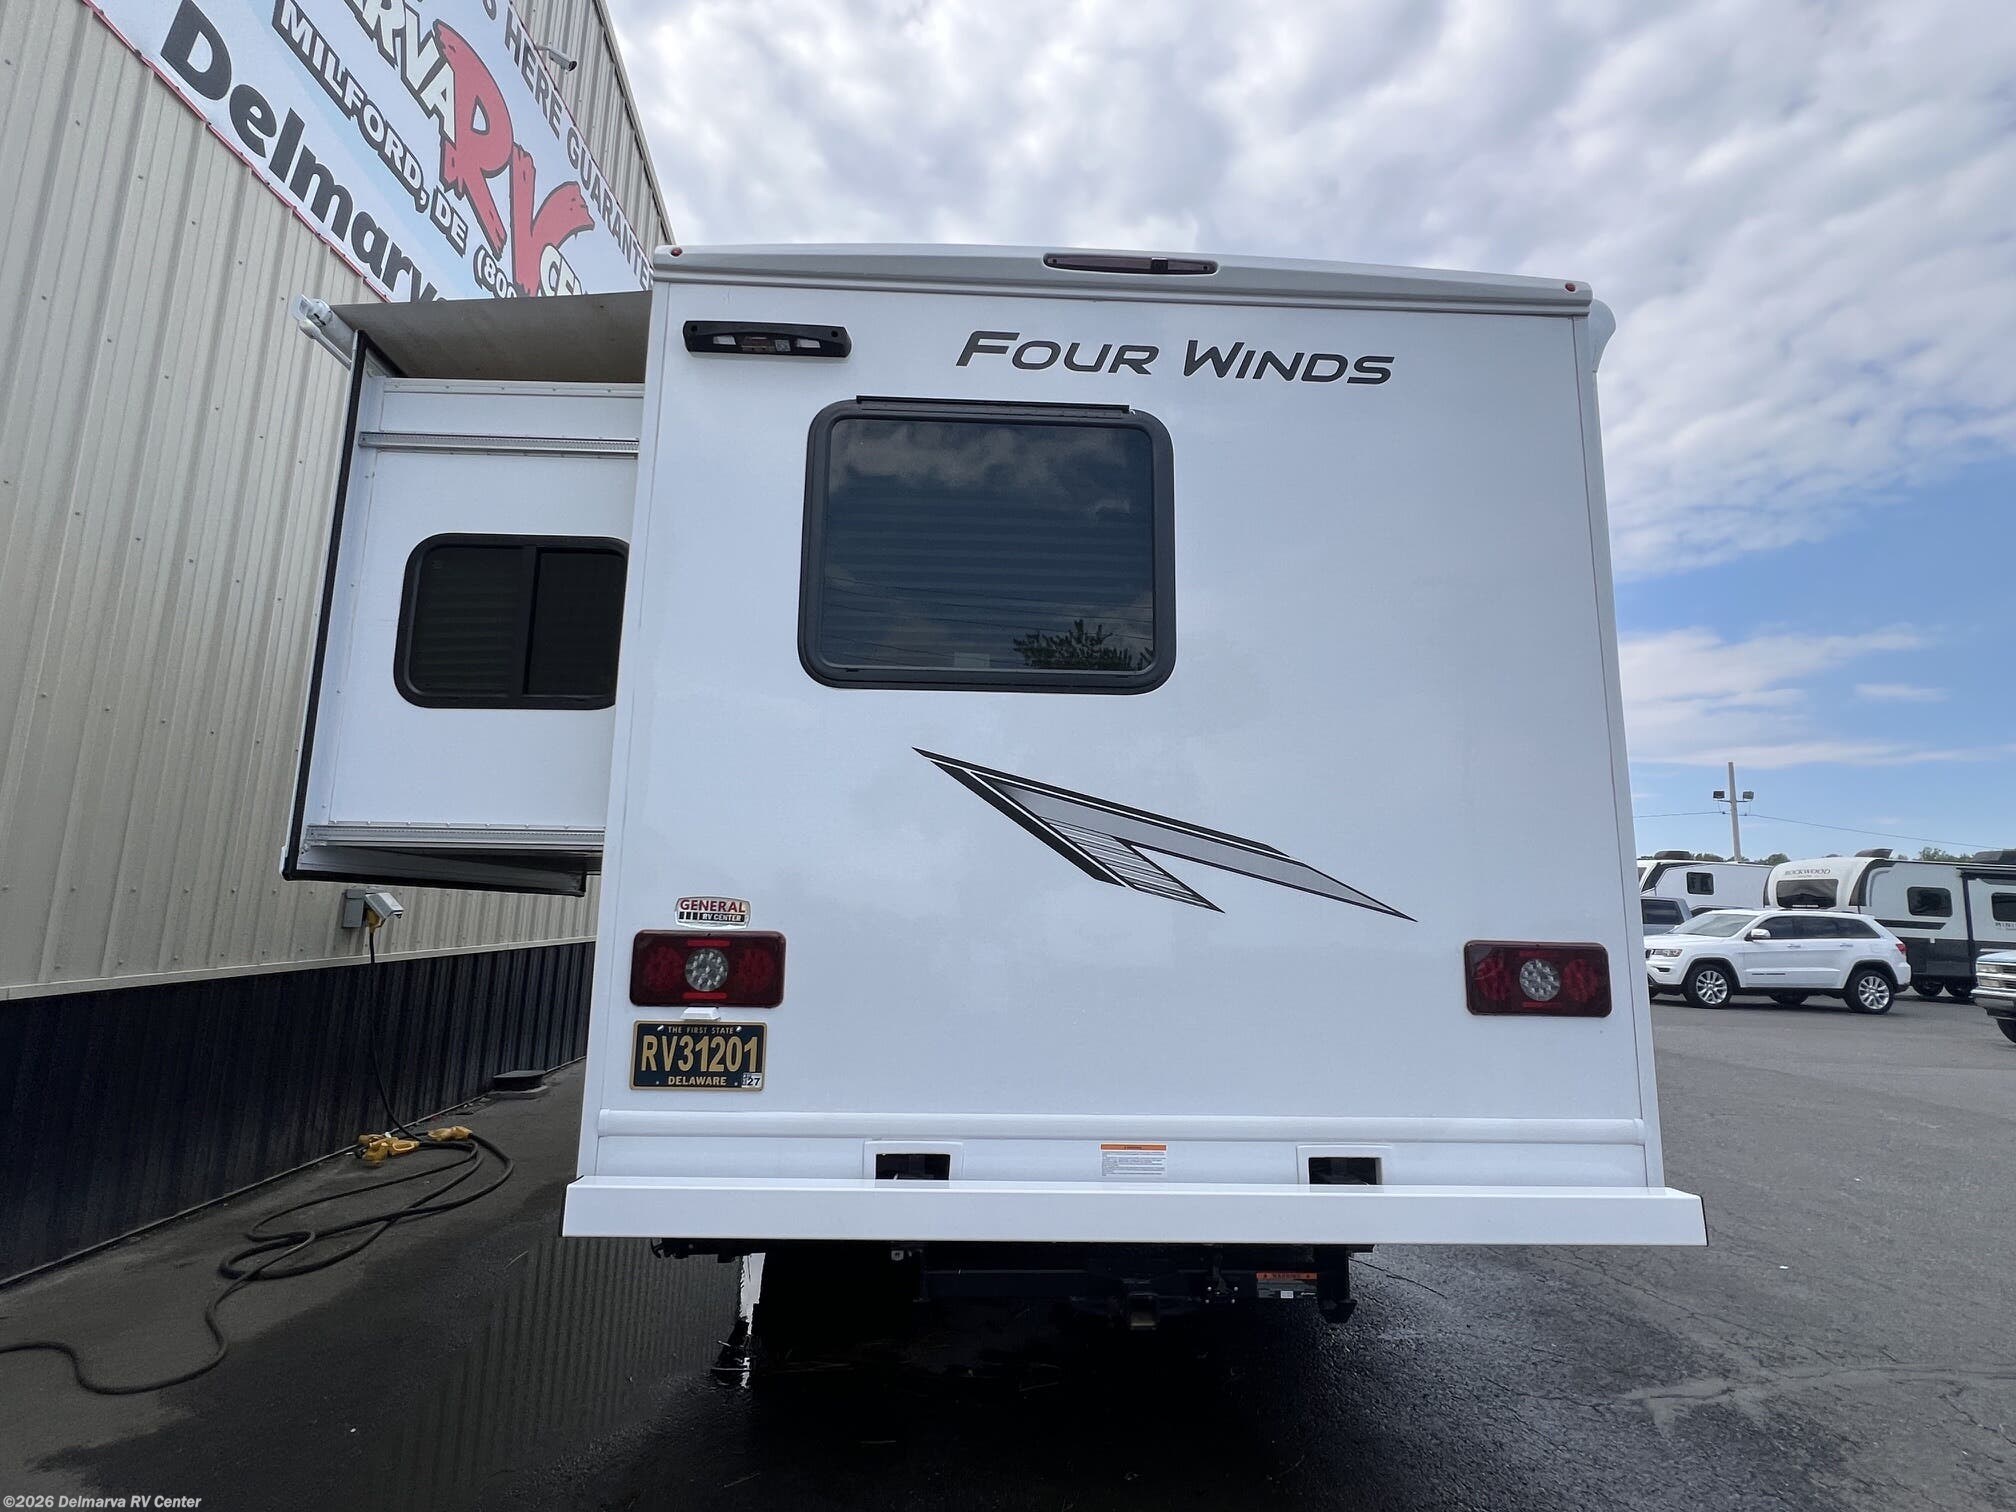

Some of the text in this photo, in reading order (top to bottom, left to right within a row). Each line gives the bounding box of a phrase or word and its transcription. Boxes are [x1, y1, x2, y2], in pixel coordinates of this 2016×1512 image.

[505, 7, 563, 141] HERE
[273, 0, 430, 212] MILFORD,
[431, 186, 468, 257] DE
[160, 0, 448, 303] Delmarv
[434, 19, 595, 298] RV
[680, 899, 746, 912] GENERAL
[667, 1026, 682, 1034] THE
[686, 1026, 707, 1034] FIRST
[641, 1035, 758, 1072] RV31201
[668, 1076, 727, 1085] DELAWARE
[747, 1077, 760, 1085] 27
